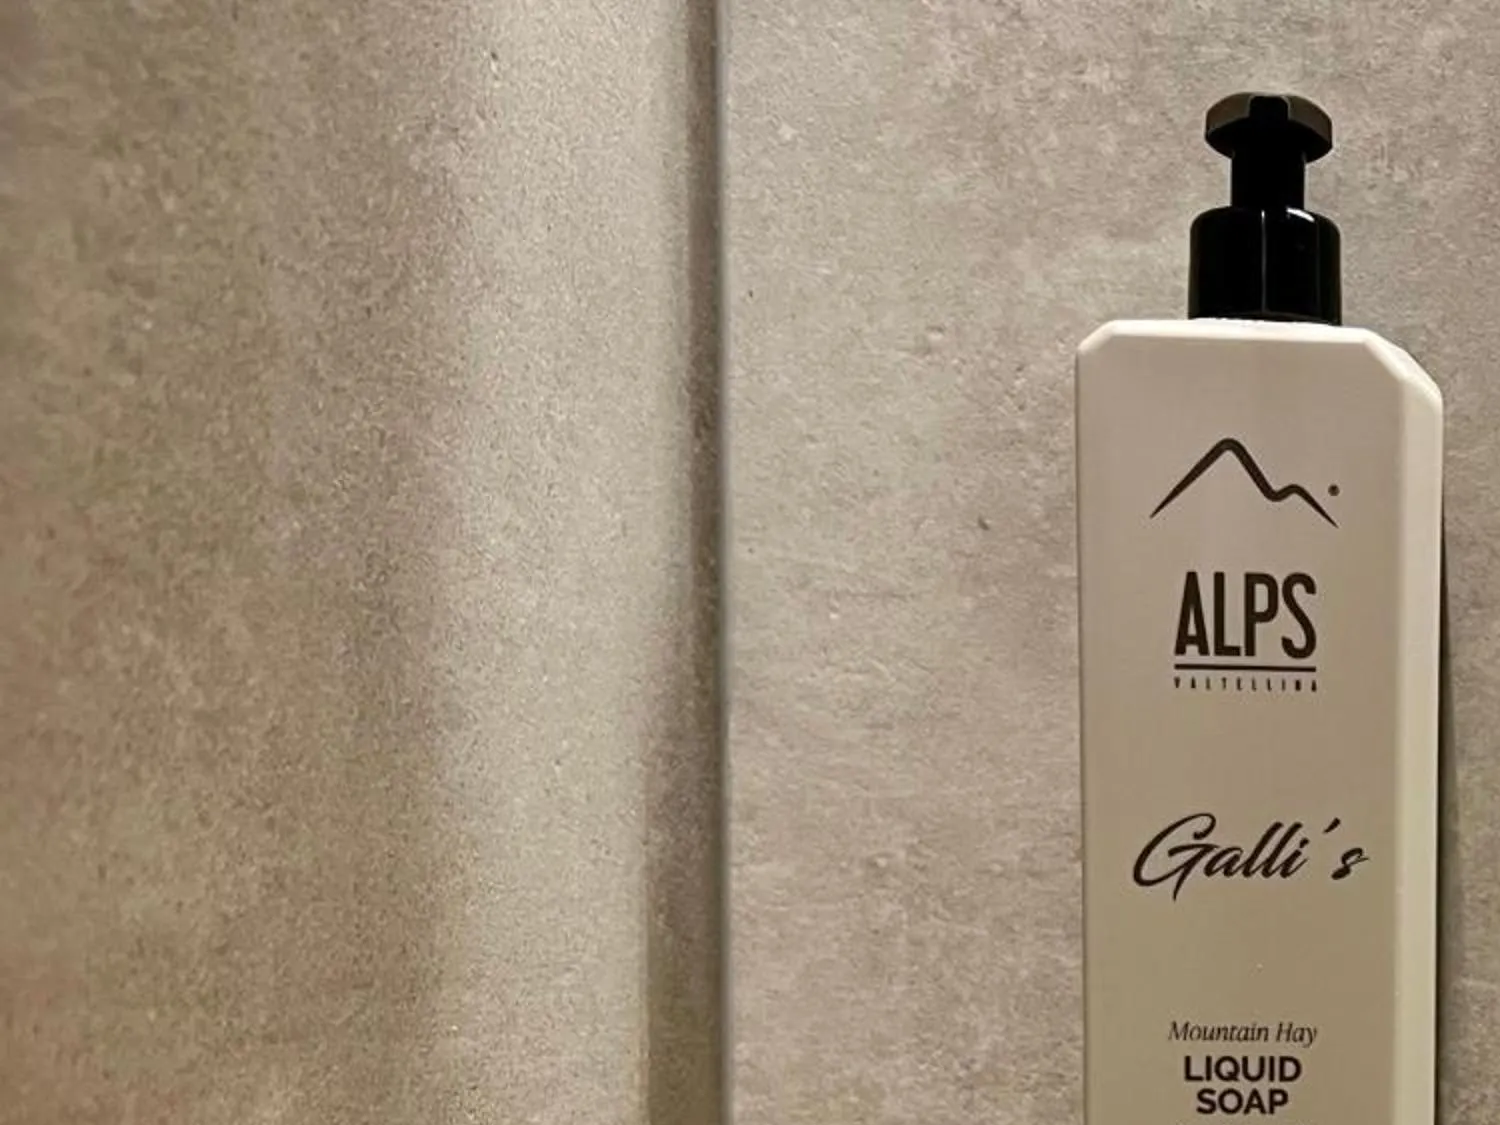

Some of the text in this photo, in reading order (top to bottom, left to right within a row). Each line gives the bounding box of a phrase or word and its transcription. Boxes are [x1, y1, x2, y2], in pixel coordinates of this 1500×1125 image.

[1174, 571, 1317, 659] ALPS
[1133, 812, 1370, 901] Galli's
[1168, 1021, 1318, 1049] Mountain Hay
[1183, 1055, 1303, 1083] LIQUID
[1196, 1088, 1289, 1115] SOAP
